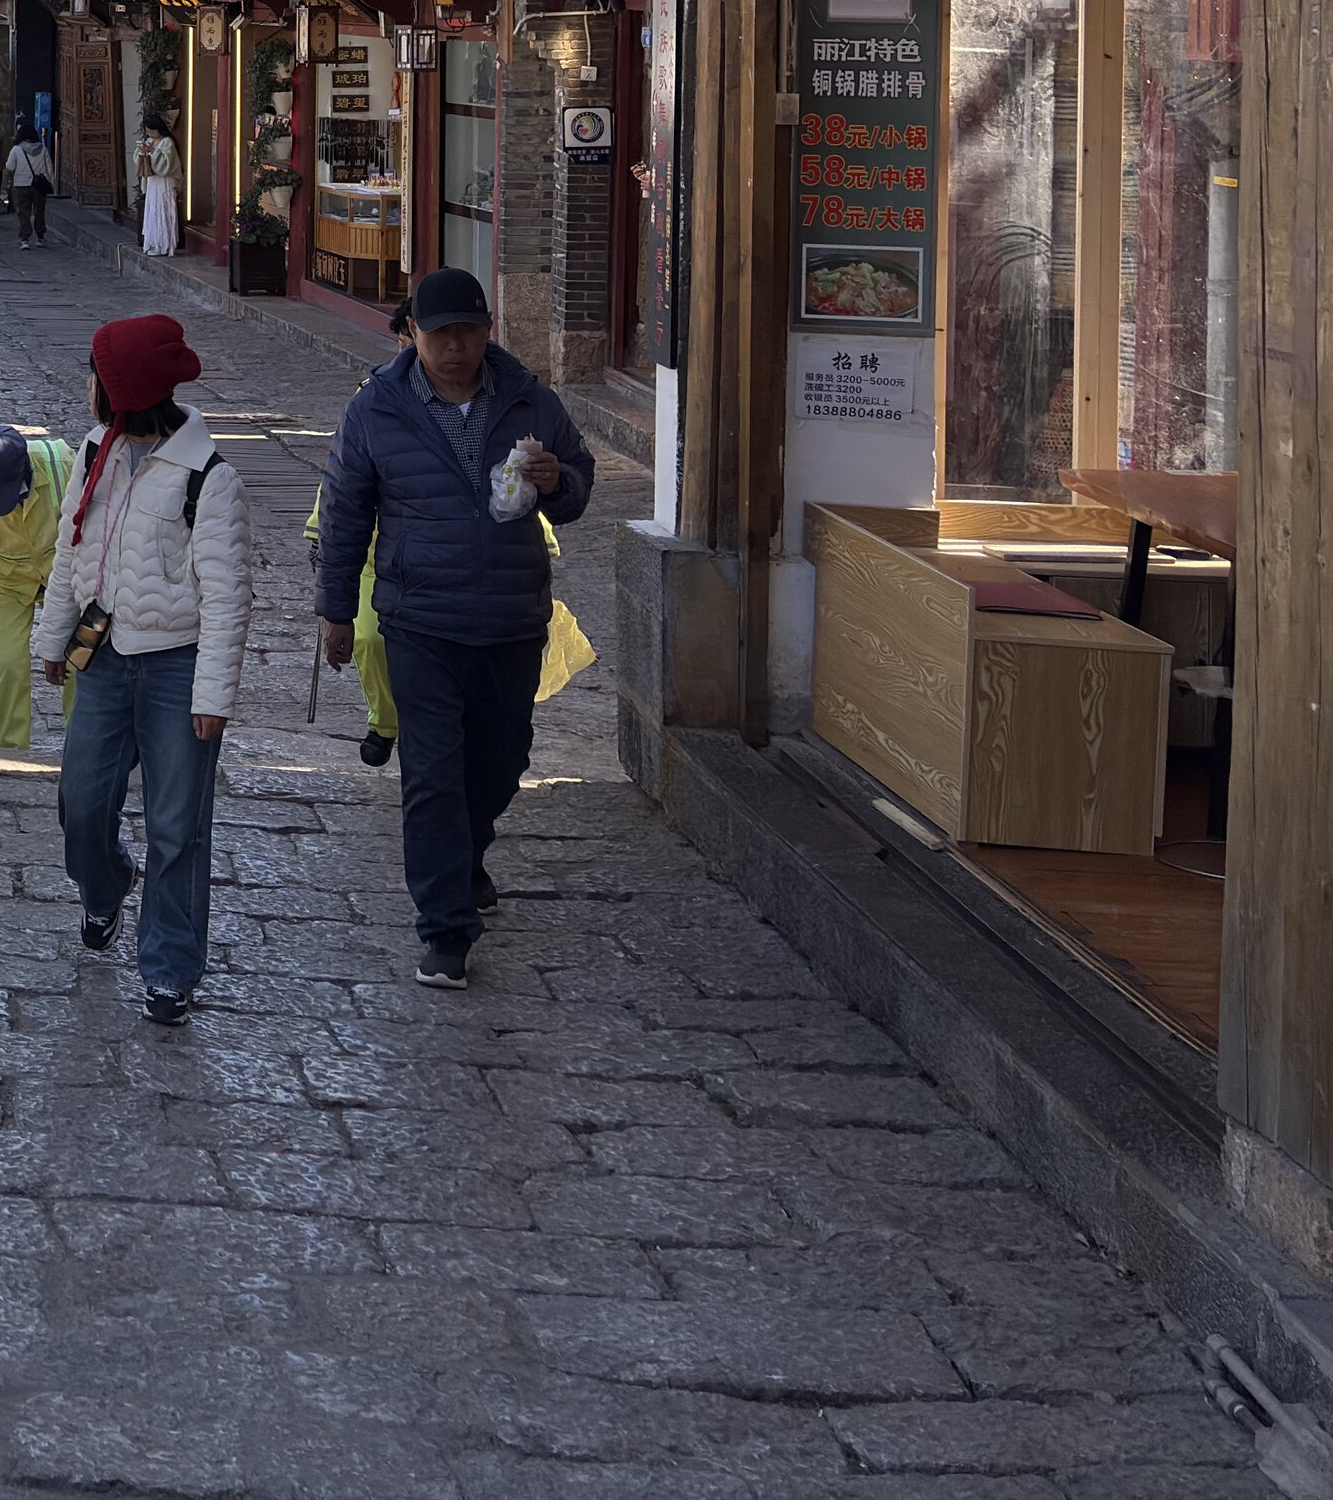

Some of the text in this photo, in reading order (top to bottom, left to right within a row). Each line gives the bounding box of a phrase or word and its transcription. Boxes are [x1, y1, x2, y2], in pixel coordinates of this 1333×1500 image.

[813, 38, 922, 63] 丽江特色
[335, 73, 367, 84] 琥珀
[812, 68, 926, 99] 铜锅腊排骨
[801, 113, 928, 150] 38元/小锅
[800, 154, 926, 190] 58元/中锅
[799, 195, 926, 232] 78元/大锅
[831, 351, 880, 373] 招聘
[804, 382, 862, 394] 洗碗工 3200
[805, 372, 906, 387] 服务员 3200-5000元
[835, 395, 890, 406] 3500元以上
[805, 404, 902, 421] 18388804886
